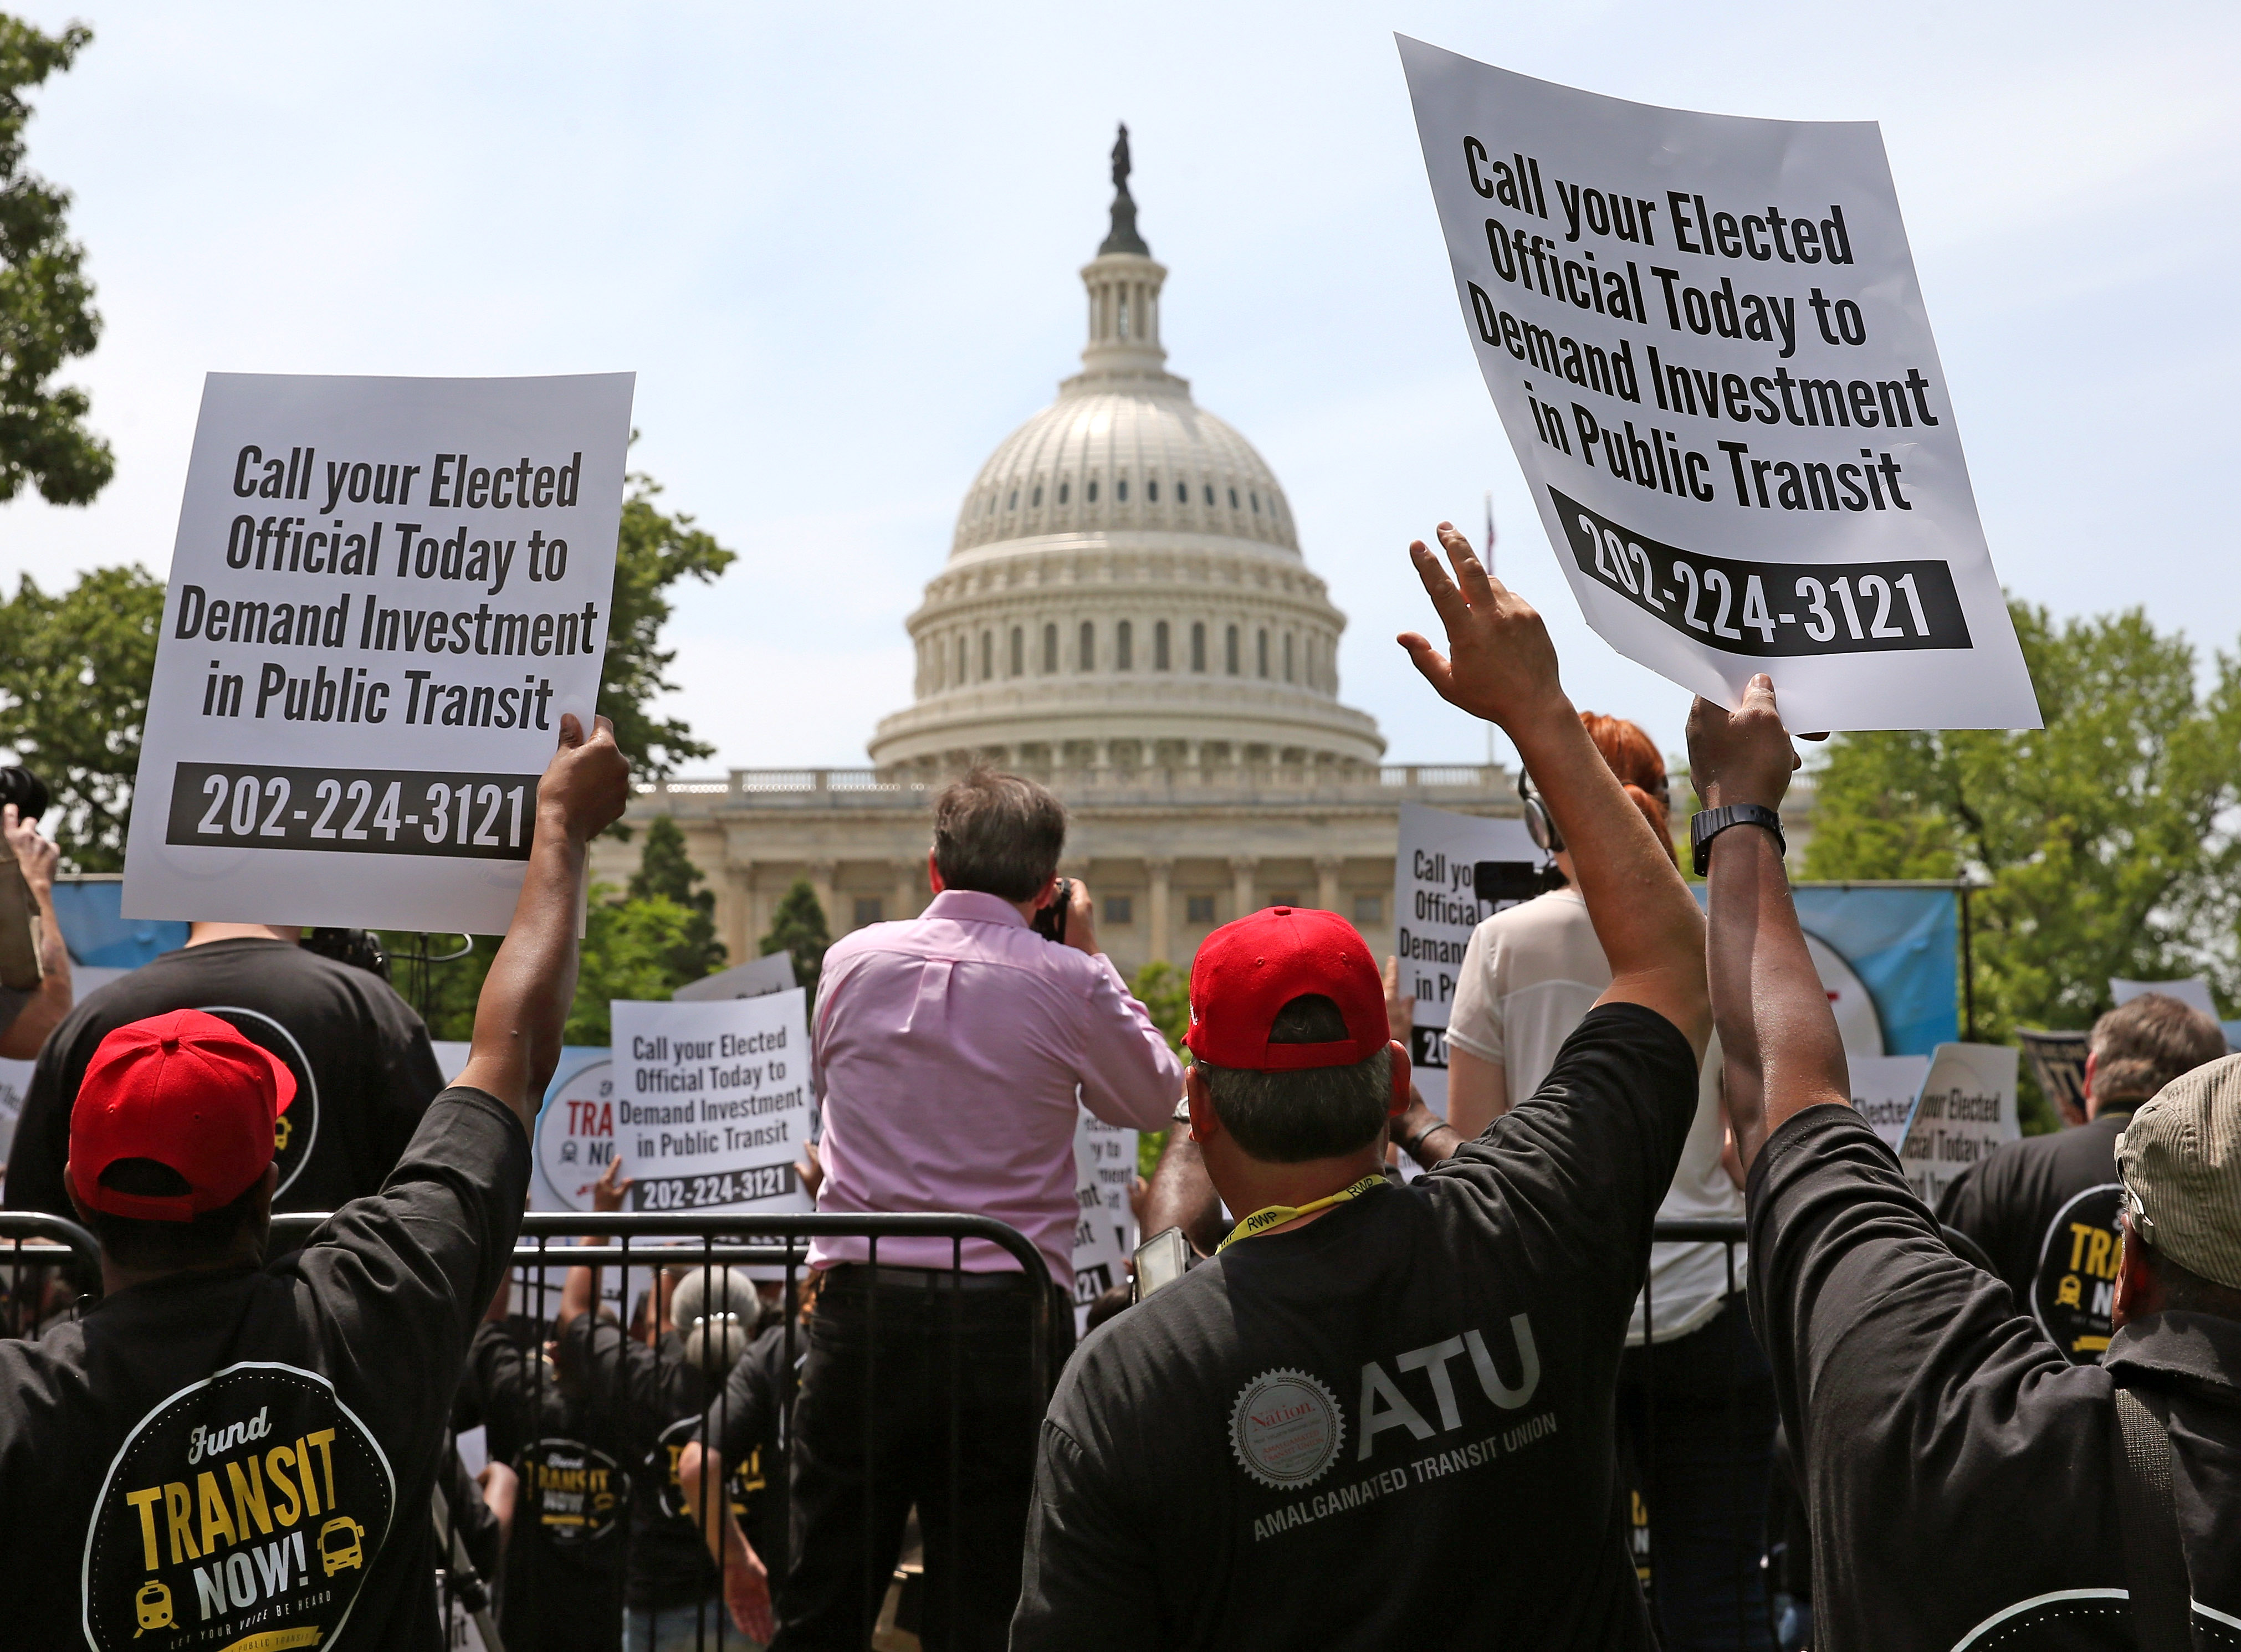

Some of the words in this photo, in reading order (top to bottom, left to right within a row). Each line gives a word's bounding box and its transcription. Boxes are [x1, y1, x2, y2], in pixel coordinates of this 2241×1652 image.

[1463, 135, 1547, 218] Call
[1556, 179, 1656, 246] your
[1667, 191, 1854, 265] Elected
[1485, 218, 1648, 324] Official
[1651, 266, 1795, 358] Today
[1809, 288, 1866, 347] to
[1467, 280, 1640, 403] Demand
[1649, 346, 1938, 428] Investment
[1524, 381, 1571, 455] in
[1572, 402, 1714, 503] Public
[1718, 440, 1913, 512] Transit
[233, 445, 314, 500] Call
[320, 461, 419, 514] your
[429, 452, 581, 508] Elected
[227, 515, 381, 576] Official
[395, 524, 516, 595] Today
[528, 530, 567, 582] to
[1579, 514, 1931, 643] 202-224-3121
[175, 584, 349, 647] Demand
[360, 594, 597, 656] Investment
[202, 660, 243, 717] in
[255, 663, 389, 723] Public
[405, 670, 552, 730] Transit
[197, 774, 520, 846] 202-224-3121
[1414, 850, 1445, 883] Call
[1451, 863, 1473, 892] yo
[1415, 890, 1481, 926] Official
[1400, 928, 1467, 963] Deman
[1415, 971, 1432, 1001] in
[633, 1035, 667, 1061] Call
[674, 1041, 715, 1065] your
[721, 1027, 786, 1058] Elected
[636, 1068, 703, 1093] Official
[709, 1066, 762, 1091] Today
[769, 1059, 786, 1080] to
[620, 1101, 694, 1125] Demand
[701, 1088, 803, 1121] Investment
[636, 1133, 654, 1158] in
[662, 1130, 719, 1156] Public
[725, 1121, 789, 1150] Transit
[643, 1168, 785, 1209] 202-224-3121
[1247, 1211, 1277, 1232] RWP
[1347, 1177, 1374, 1197] RWP
[1250, 1402, 1316, 1433] Nation.
[1358, 1313, 1540, 1462] ATU
[188, 1406, 272, 1465] Fund
[126, 1428, 335, 1571] TRANSIT
[1253, 1466, 1408, 1542] AMALGAMATED
[1411, 1436, 1497, 1483] TRANSIT
[1503, 1412, 1558, 1454] UNION
[193, 1531, 309, 1621] NOW!
[171, 1635, 190, 1650] LET
[201, 1624, 231, 1640] YOUR
[239, 1608, 268, 1631] VOICE
[275, 1603, 289, 1617] BE
[298, 1590, 331, 1612] HEARD
[238, 1638, 270, 1652] PUBLIC
[275, 1633, 309, 1645] TRANSIT
